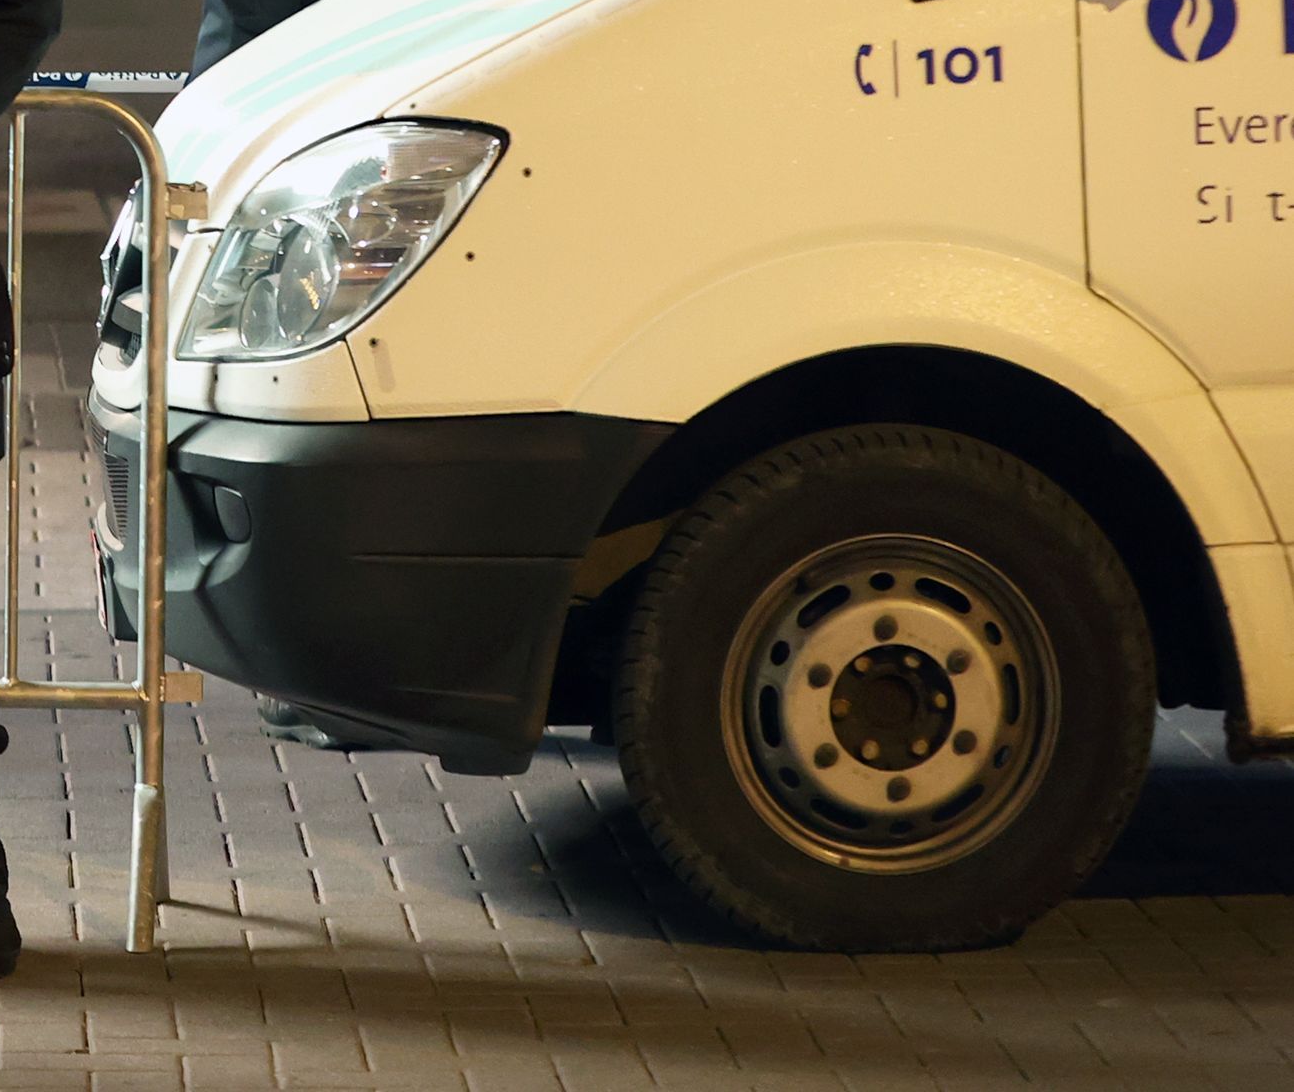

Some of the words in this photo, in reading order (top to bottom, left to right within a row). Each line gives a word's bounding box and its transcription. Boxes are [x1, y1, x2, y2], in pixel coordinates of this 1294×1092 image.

[916, 46, 1004, 85] 101
[1195, 106, 1294, 145] Ever
[1196, 184, 1233, 224] Si
